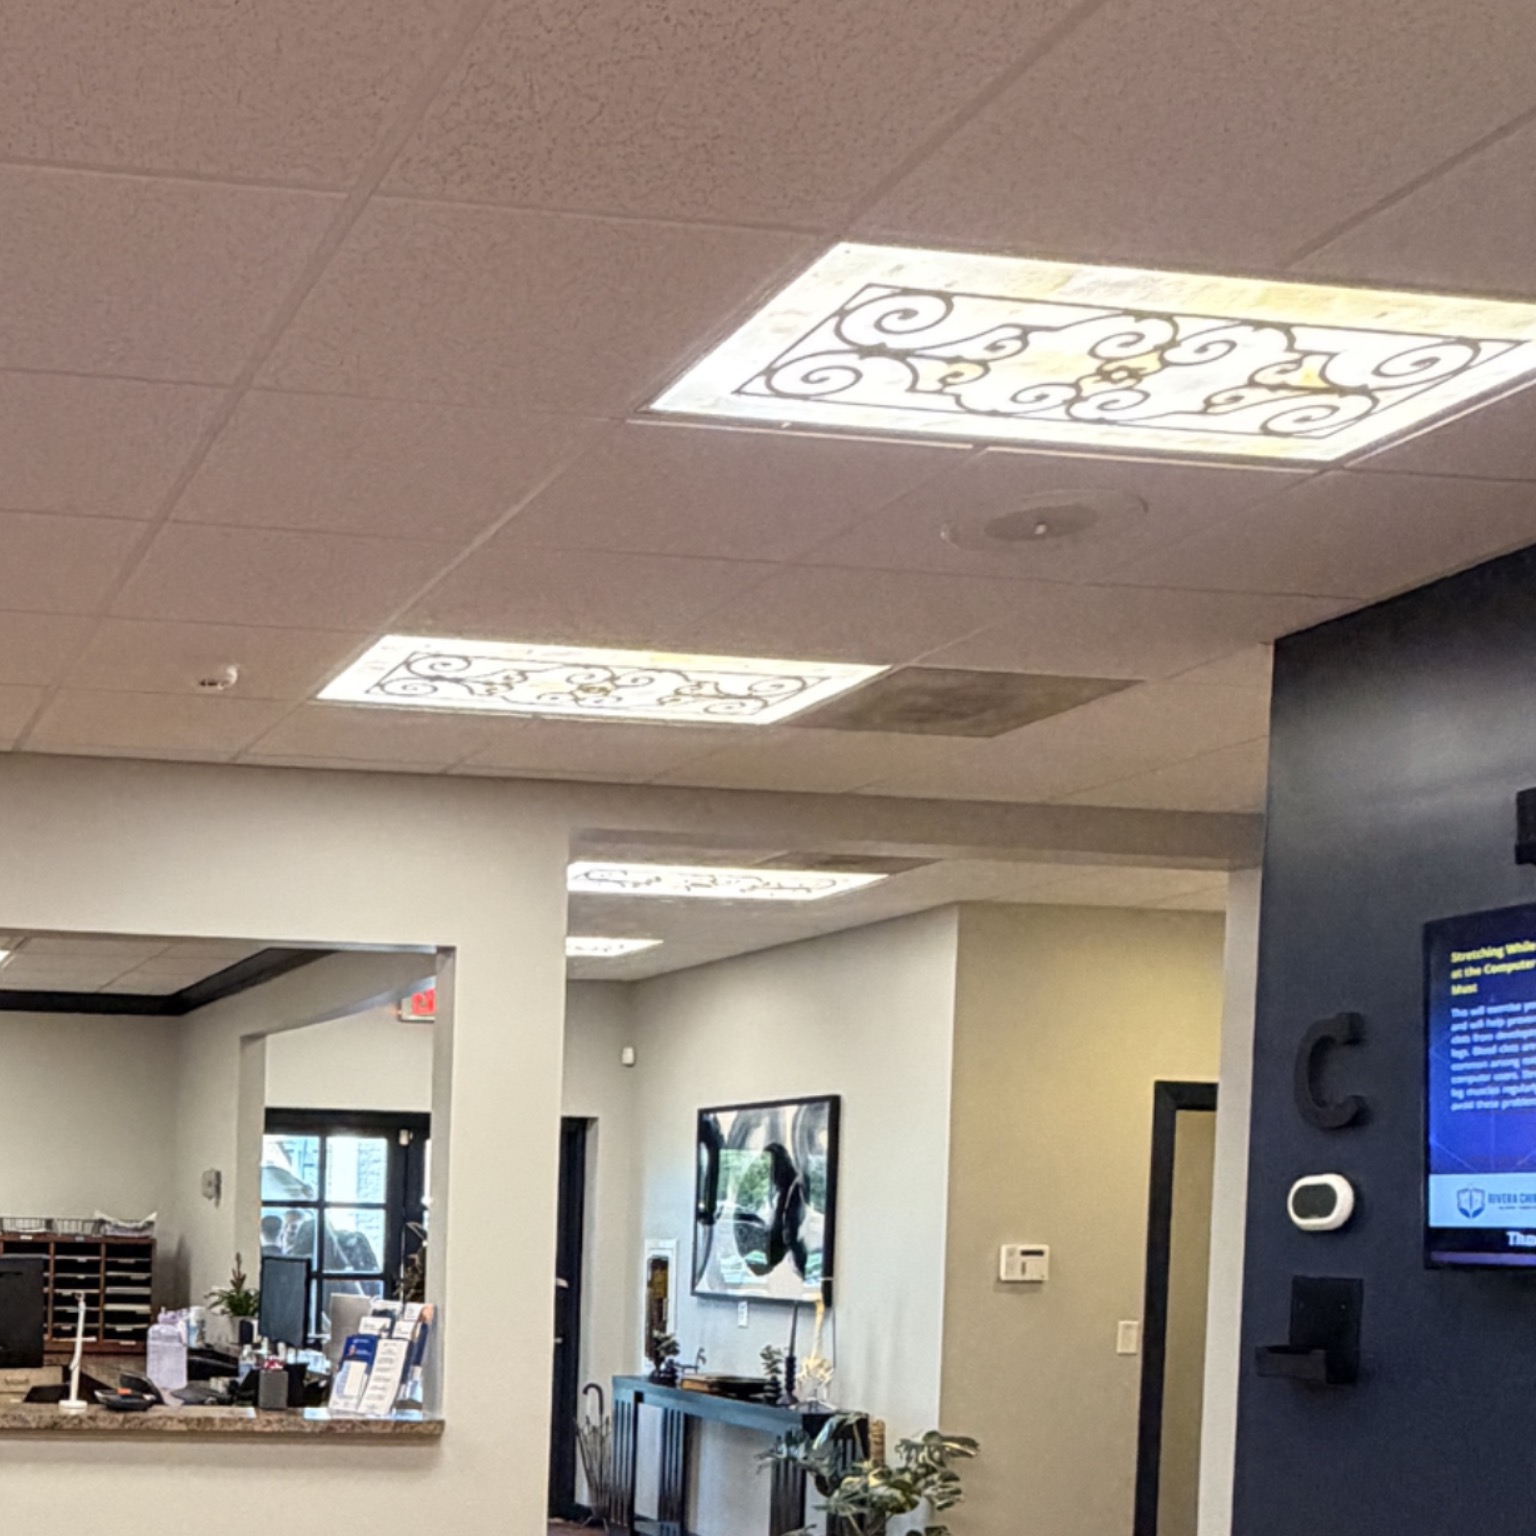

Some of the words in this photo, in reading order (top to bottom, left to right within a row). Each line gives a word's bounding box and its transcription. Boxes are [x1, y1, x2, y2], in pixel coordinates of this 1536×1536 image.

[1451, 947, 1504, 962] Stretching
[1451, 970, 1463, 980] at
[1464, 967, 1482, 977] the
[1484, 960, 1536, 974] Computer
[1451, 984, 1478, 995] Must
[1469, 1006, 1485, 1016] will
[1485, 1019, 1505, 1029] help
[1472, 1033, 1494, 1043] from
[1294, 1012, 1364, 1130] C
[1451, 1074, 1492, 1084] computer
